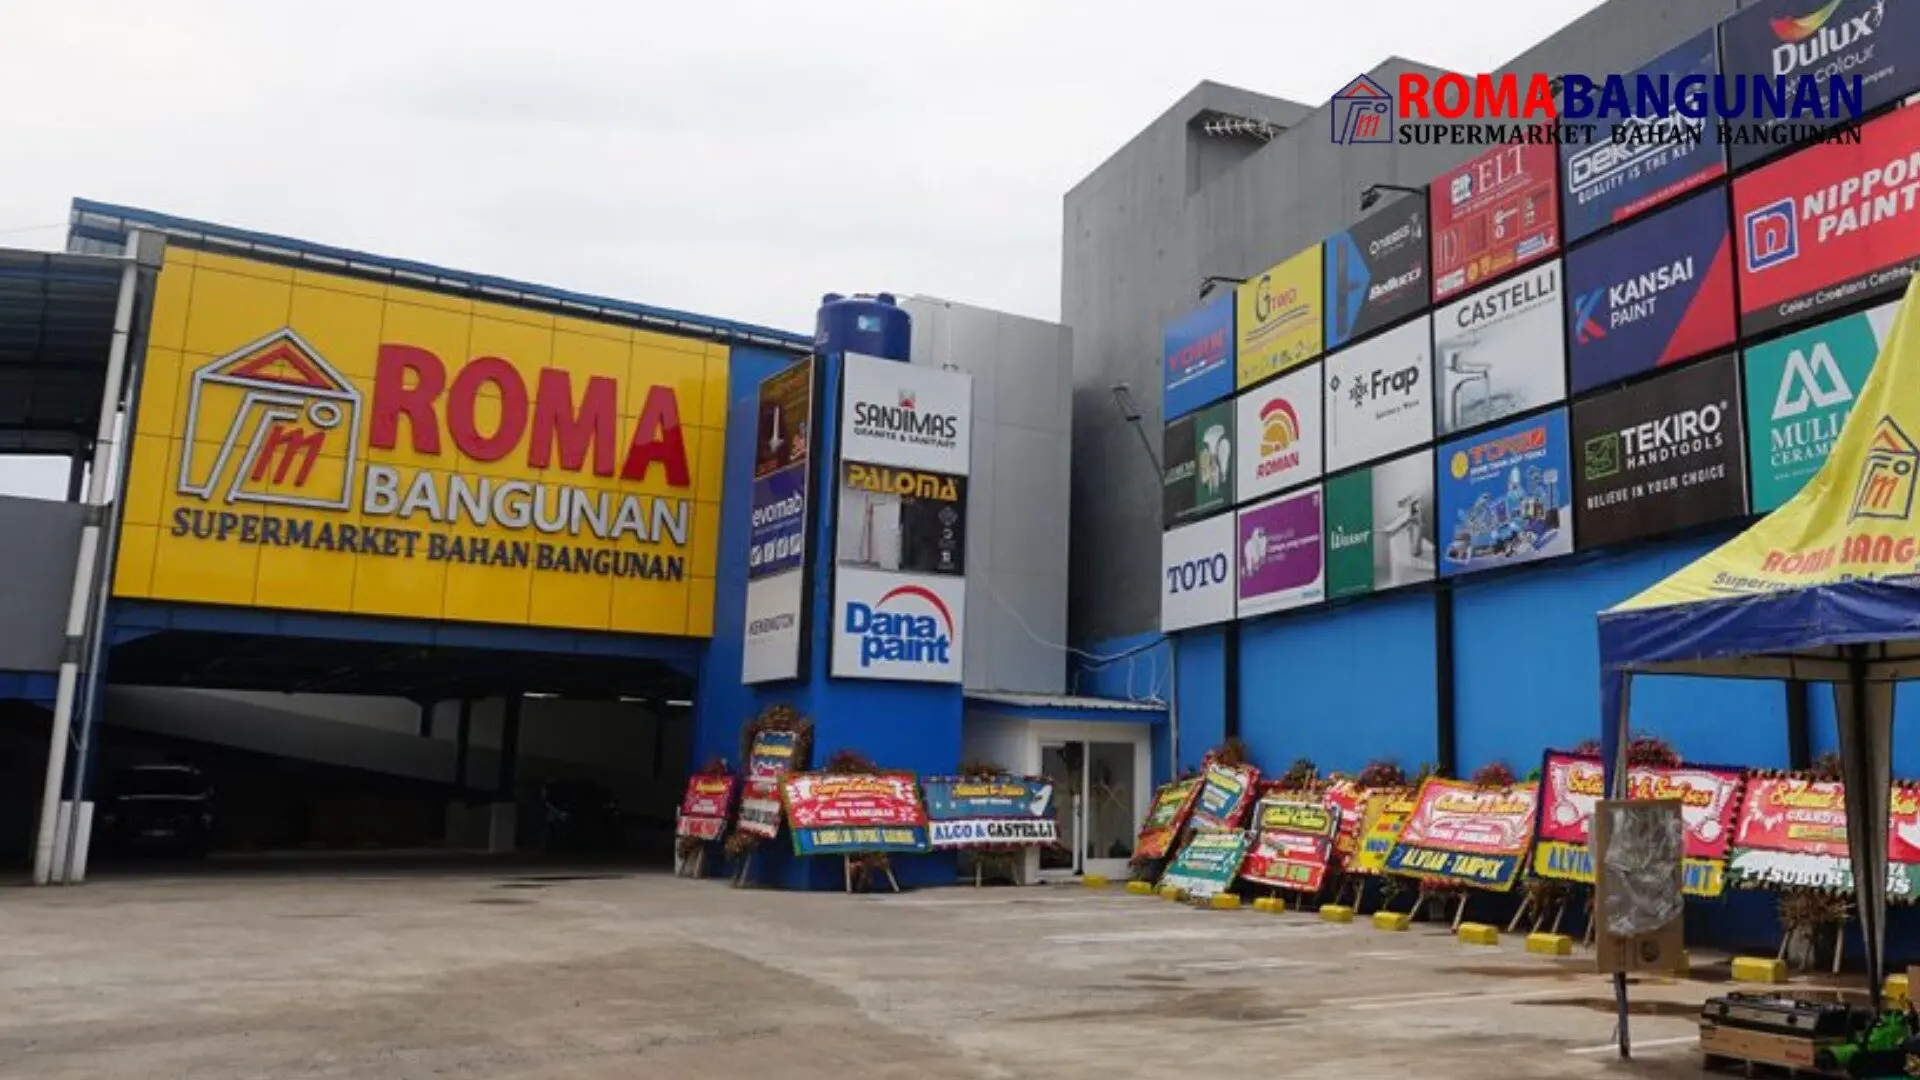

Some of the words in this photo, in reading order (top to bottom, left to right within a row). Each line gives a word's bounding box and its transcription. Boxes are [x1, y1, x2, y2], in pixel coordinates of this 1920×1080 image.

[1772, 10, 1873, 80] Dulux
[1818, 180, 1920, 243] PAINT
[1457, 269, 1556, 328] CASTELLI
[1609, 255, 1694, 309] KANSAI
[1611, 297, 1657, 330] PAINT
[1371, 366, 1419, 400] Frap
[368, 343, 691, 487] ROMA
[1620, 404, 1721, 455] TEKIRO
[1771, 411, 1851, 451] MULI
[1255, 451, 1300, 480] ROMAN
[1625, 432, 1724, 470] HANDTOOLS
[848, 464, 959, 502] PALOMA
[361, 464, 688, 546] BANGUNAN
[171, 507, 421, 558] SUPERMARKET
[426, 531, 530, 570] BAHAN
[535, 541, 684, 582] BANGUNAN
[1167, 552, 1228, 594] TOTO
[846, 602, 937, 639] Dana
[861, 634, 949, 668] paint
[987, 821, 1053, 840] CASTELLI
